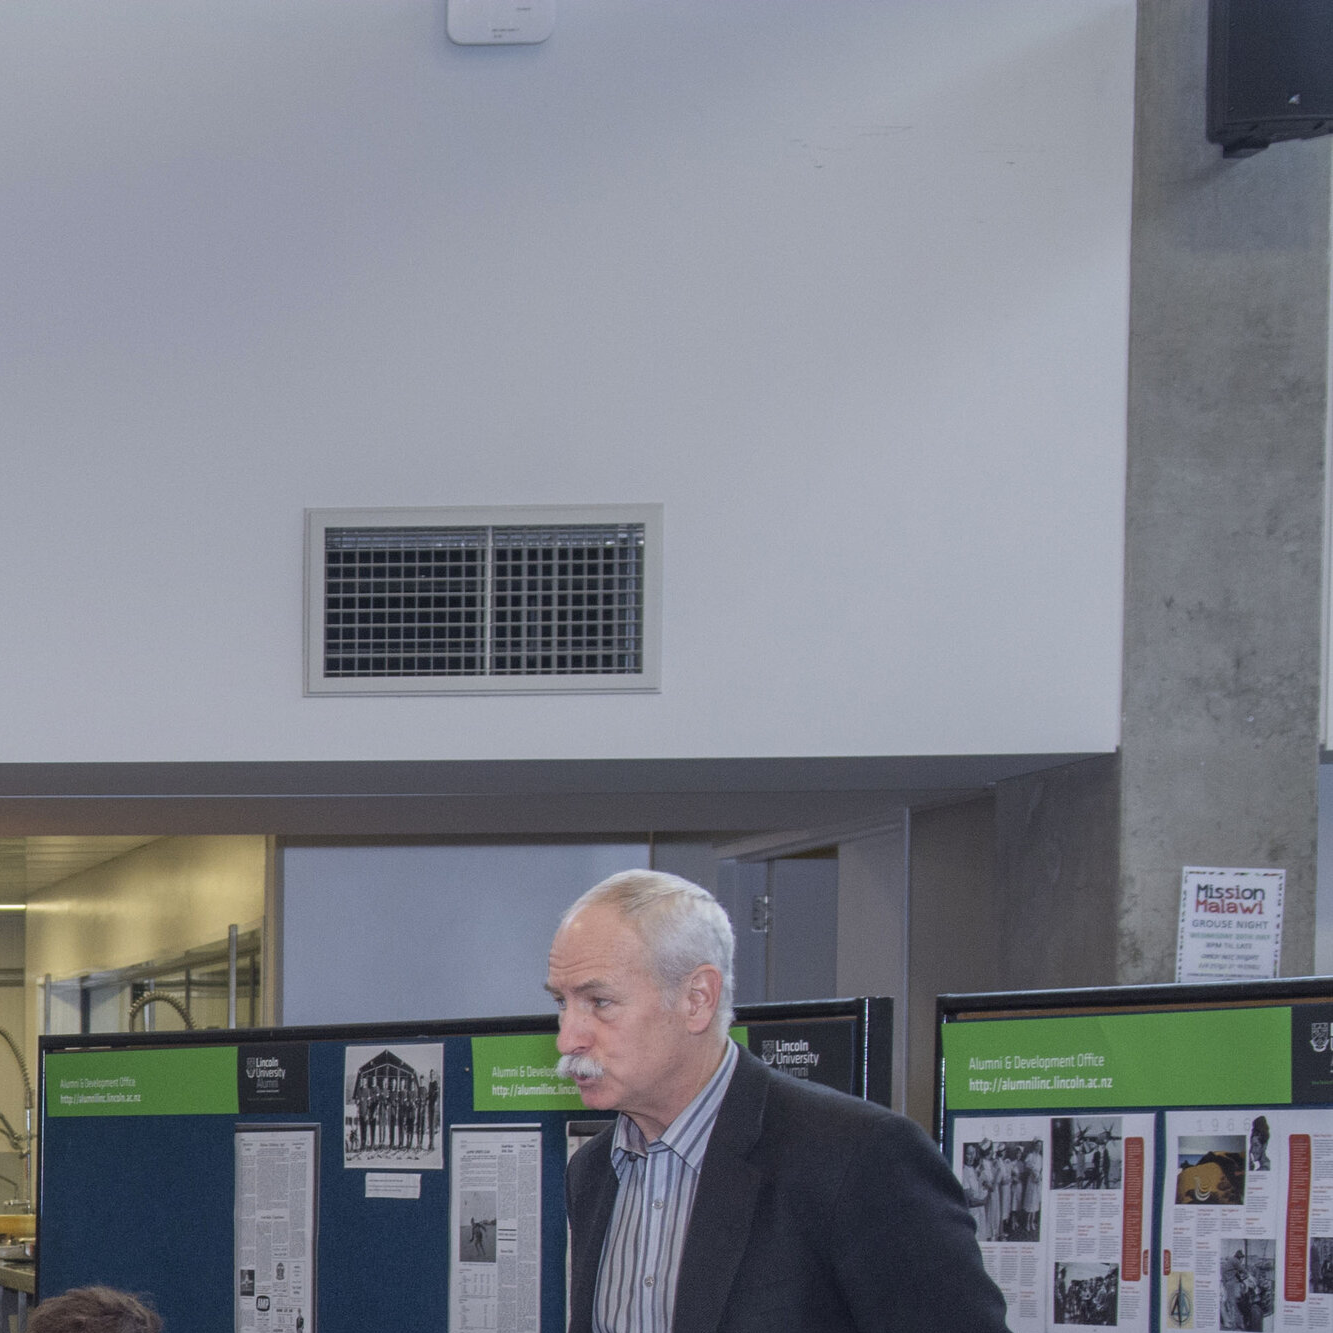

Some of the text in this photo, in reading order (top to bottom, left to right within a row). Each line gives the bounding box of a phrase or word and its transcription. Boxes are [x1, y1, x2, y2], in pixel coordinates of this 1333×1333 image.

[1197, 883, 1265, 900] Mission
[1195, 898, 1264, 915] Malawi
[1192, 920, 1268, 929] GROUSE NIGHT
[776, 1040, 809, 1052] Lincoln
[256, 1056, 279, 1068] Lincoln
[776, 1052, 820, 1067] University
[969, 1053, 1105, 1071] Alumni & Development Office
[256, 1067, 286, 1080] University
[492, 1066, 557, 1080] Alumni & Develop
[969, 1076, 1113, 1094] http://alumnilinc.lincoln.ac.nz
